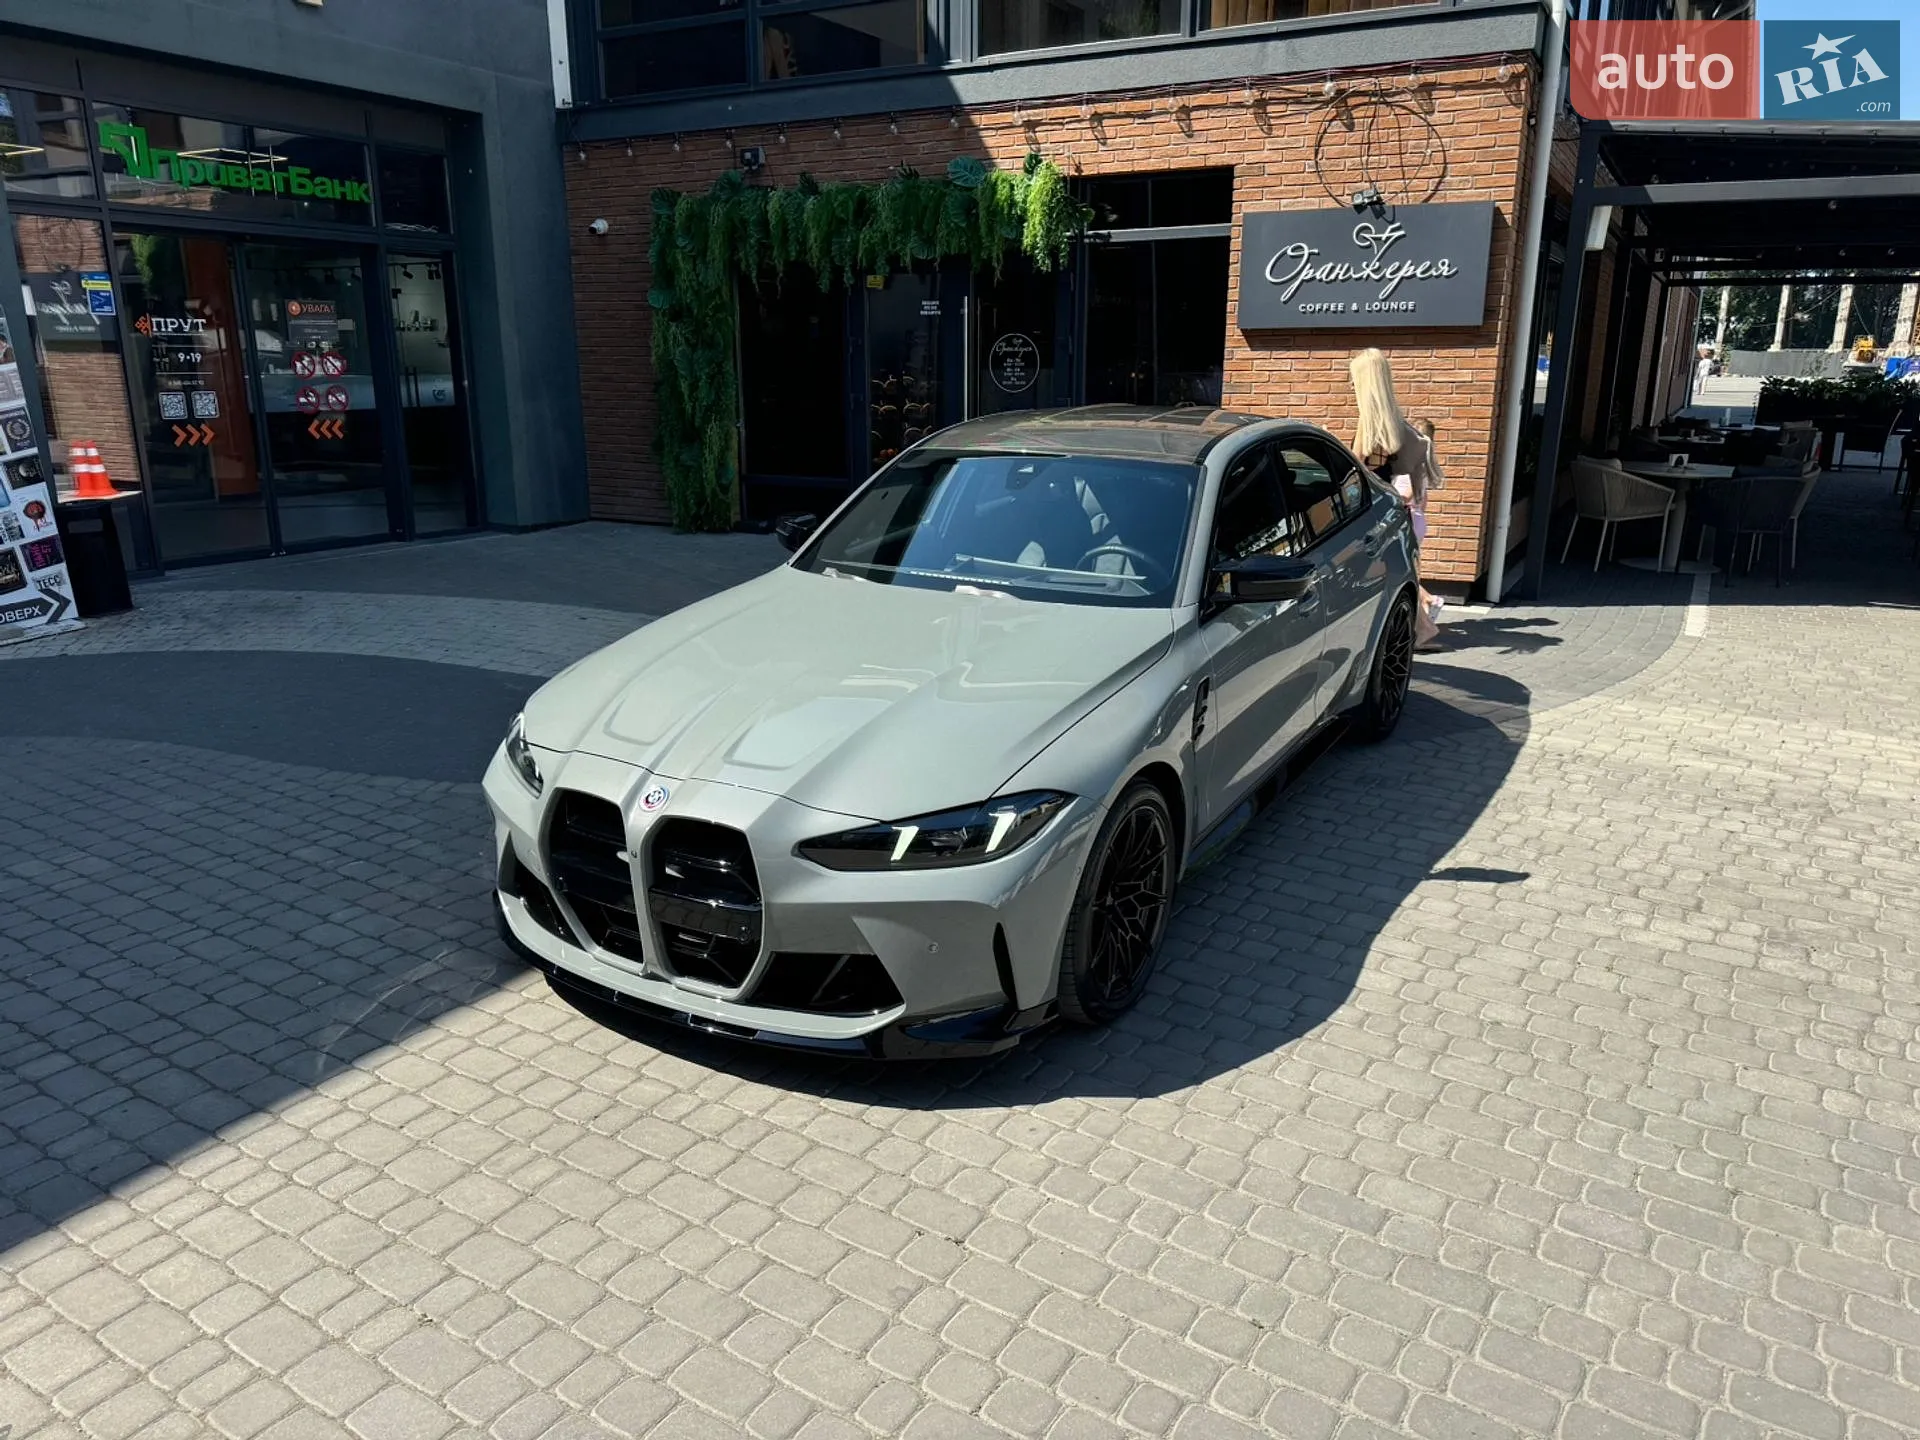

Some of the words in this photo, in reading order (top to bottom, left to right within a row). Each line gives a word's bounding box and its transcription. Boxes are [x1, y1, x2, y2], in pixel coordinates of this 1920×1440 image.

[150, 147, 372, 204] ПриватБанк
[1265, 240, 1459, 303] Оранжерея
[151, 317, 207, 332] ПРУТ
[1298, 302, 1345, 313] COFFEE
[1351, 302, 1359, 312] &
[1365, 301, 1416, 312] LOUNGE
